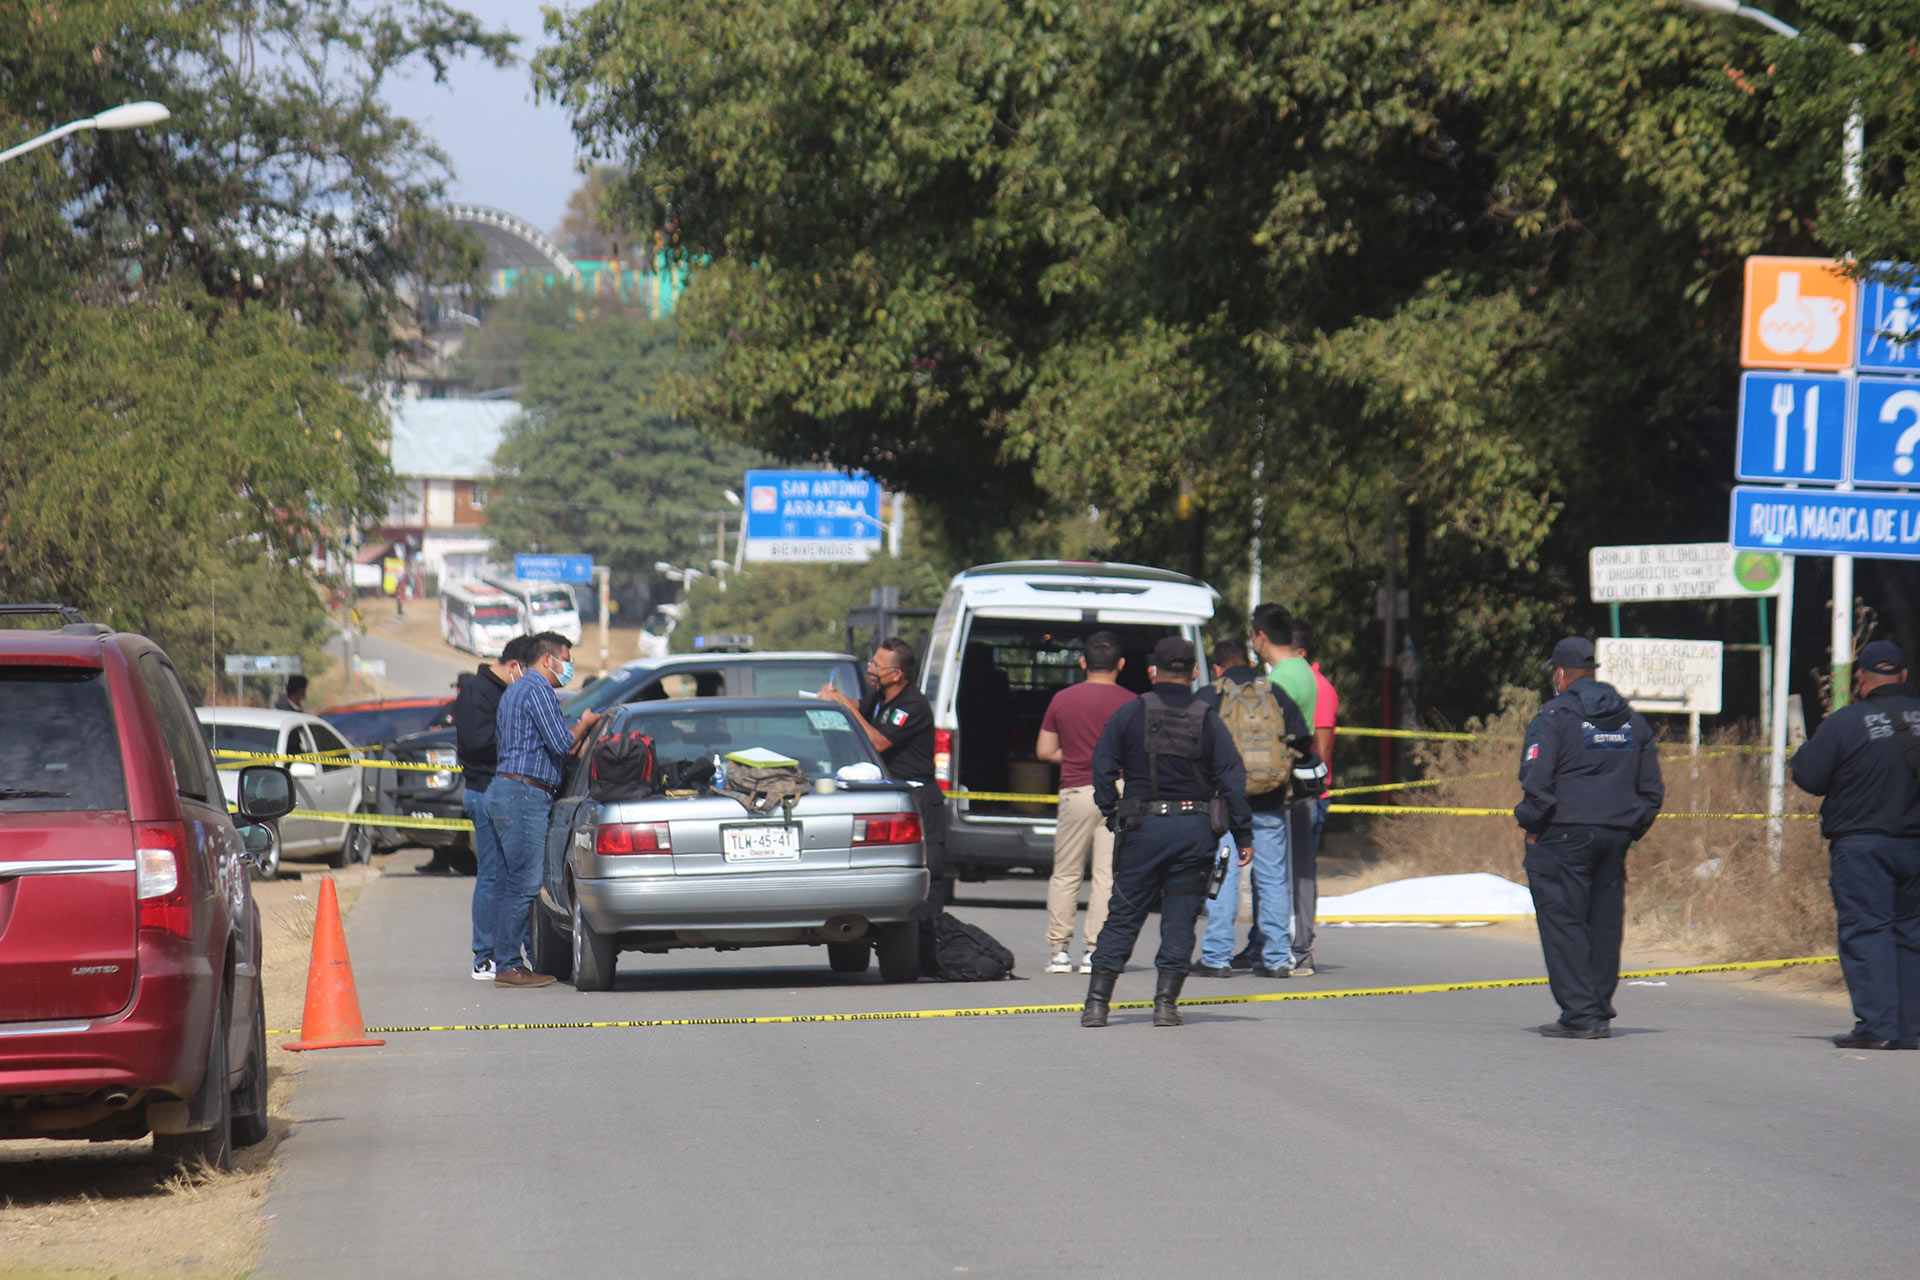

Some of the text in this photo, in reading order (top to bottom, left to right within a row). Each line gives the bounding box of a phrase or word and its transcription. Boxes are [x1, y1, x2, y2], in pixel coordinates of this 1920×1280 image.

[781, 480, 869, 498] SAN ANTONIO
[1751, 503, 1798, 538] RUTA
[1801, 505, 1869, 542] MAGICA
[1871, 509, 1897, 543] DE
[1640, 548, 1654, 564] DE
[1607, 656, 1686, 672] SAN PEDRO
[1594, 733, 1627, 743] ESTATAL
[72, 965, 119, 975] LIMITED
